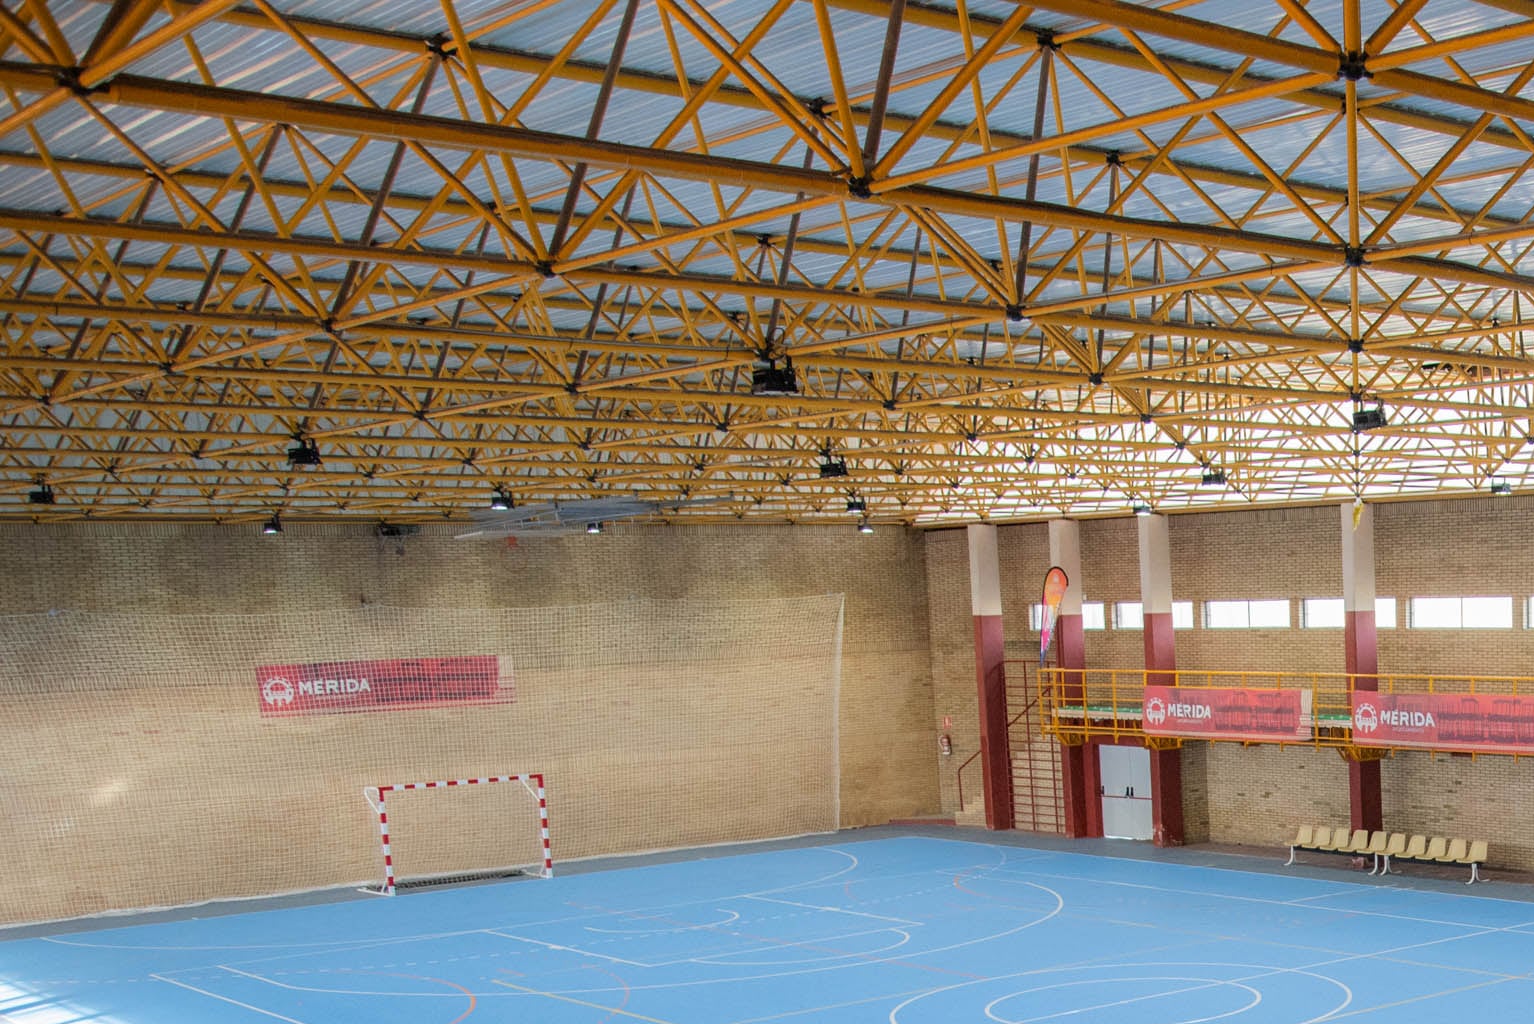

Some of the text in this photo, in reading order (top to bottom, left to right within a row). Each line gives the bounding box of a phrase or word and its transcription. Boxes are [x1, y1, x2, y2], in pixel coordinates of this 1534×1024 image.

[299, 678, 371, 696] MÉRIDA
[1167, 702, 1212, 719] MÉRIDA
[1380, 709, 1436, 728] MÉRIDA
